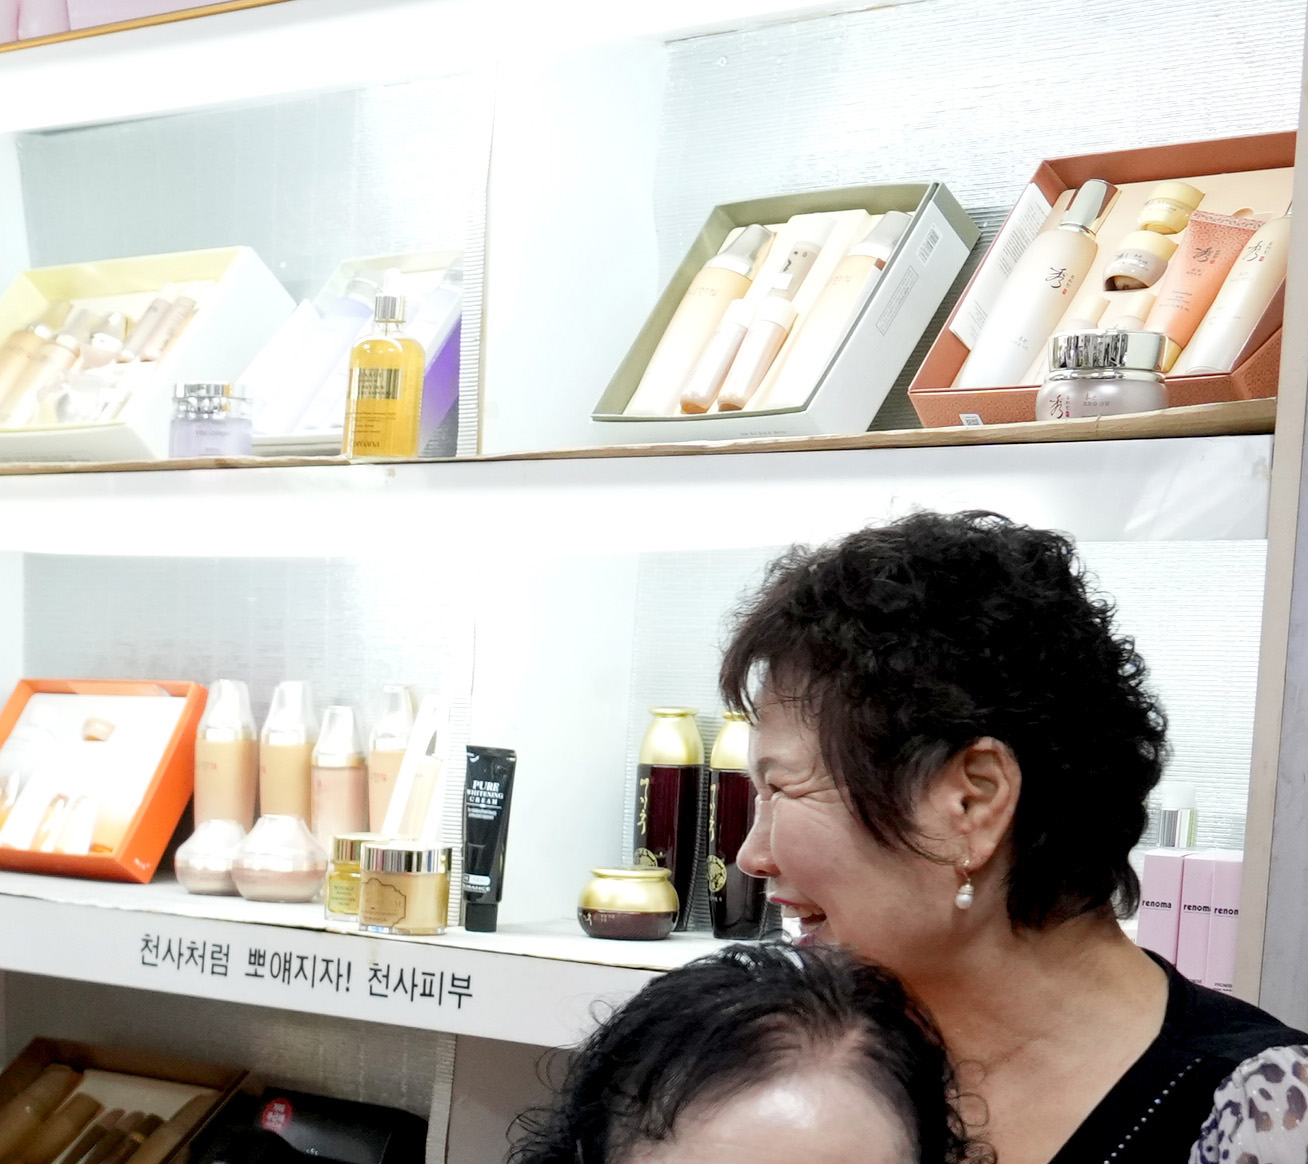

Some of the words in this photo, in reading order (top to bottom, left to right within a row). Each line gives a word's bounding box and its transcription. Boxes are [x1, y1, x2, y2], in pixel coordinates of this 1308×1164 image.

[472, 780, 500, 792] PURE
[466, 789, 504, 800] WHITENING
[469, 797, 498, 805] CREAM
[1141, 900, 1172, 909] renoma
[1184, 903, 1212, 912] renom
[140, 933, 230, 977] 천사처럼
[368, 962, 474, 1009] 천사피부
